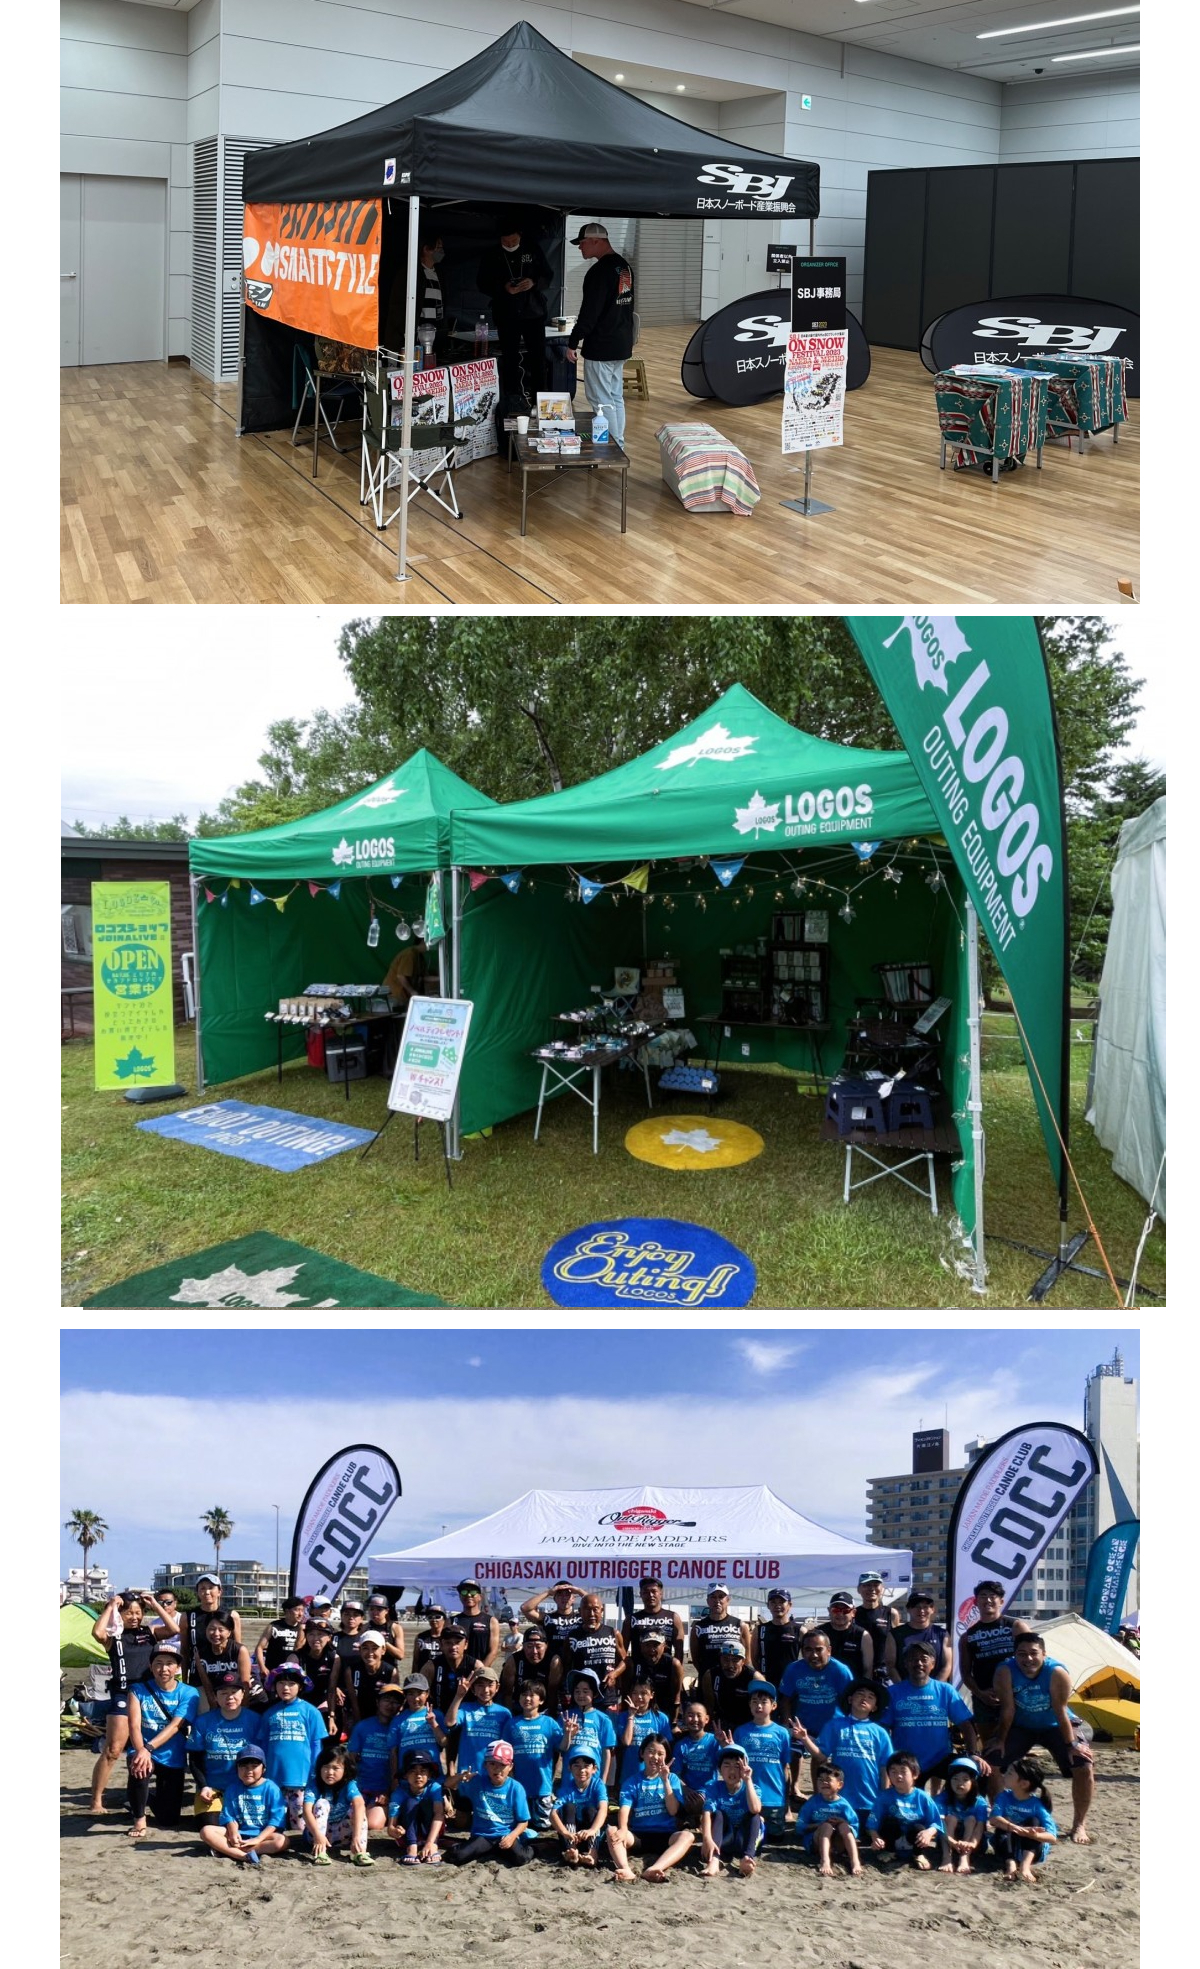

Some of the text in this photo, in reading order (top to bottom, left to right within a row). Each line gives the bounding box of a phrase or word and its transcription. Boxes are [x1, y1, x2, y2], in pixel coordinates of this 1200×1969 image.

[697, 163, 795, 200] SBJ
[697, 198, 796, 213] 日本スノーボード産業振興会
[797, 287, 841, 298] SBJ事務局
[788, 337, 846, 352] ON SNOW
[972, 316, 1127, 353] SBJ
[792, 350, 826, 359] FESTIVAL
[452, 360, 494, 378] ON SNOW
[698, 746, 741, 755] LOGOS
[942, 659, 1053, 917] LOGOS
[785, 784, 873, 824] LOGOS
[755, 816, 776, 824] LOGOS
[784, 817, 873, 836] OUTING EQUIPMENT
[356, 837, 395, 860] LOGOS
[923, 725, 1016, 952] OUTING EQUIPMENT
[106, 950, 158, 970] OPEN
[115, 983, 155, 995] 営業中
[580, 1232, 692, 1272] Enjoy
[557, 1255, 738, 1303] Outing!
[622, 1288, 676, 1300] LOGOS
[998, 1464, 1018, 1496] CANOE
[1012, 1442, 1033, 1466] CLUB
[328, 1481, 345, 1508] CANOE
[342, 1462, 357, 1483] CLUB
[971, 1444, 1086, 1580] COCC
[309, 1465, 394, 1584] COCC
[539, 1536, 589, 1544] JAPAN
[643, 1535, 728, 1543] PADDLERS
[474, 1559, 780, 1580] CHIGASAKI OUTRIGGER CANOE CLUB
